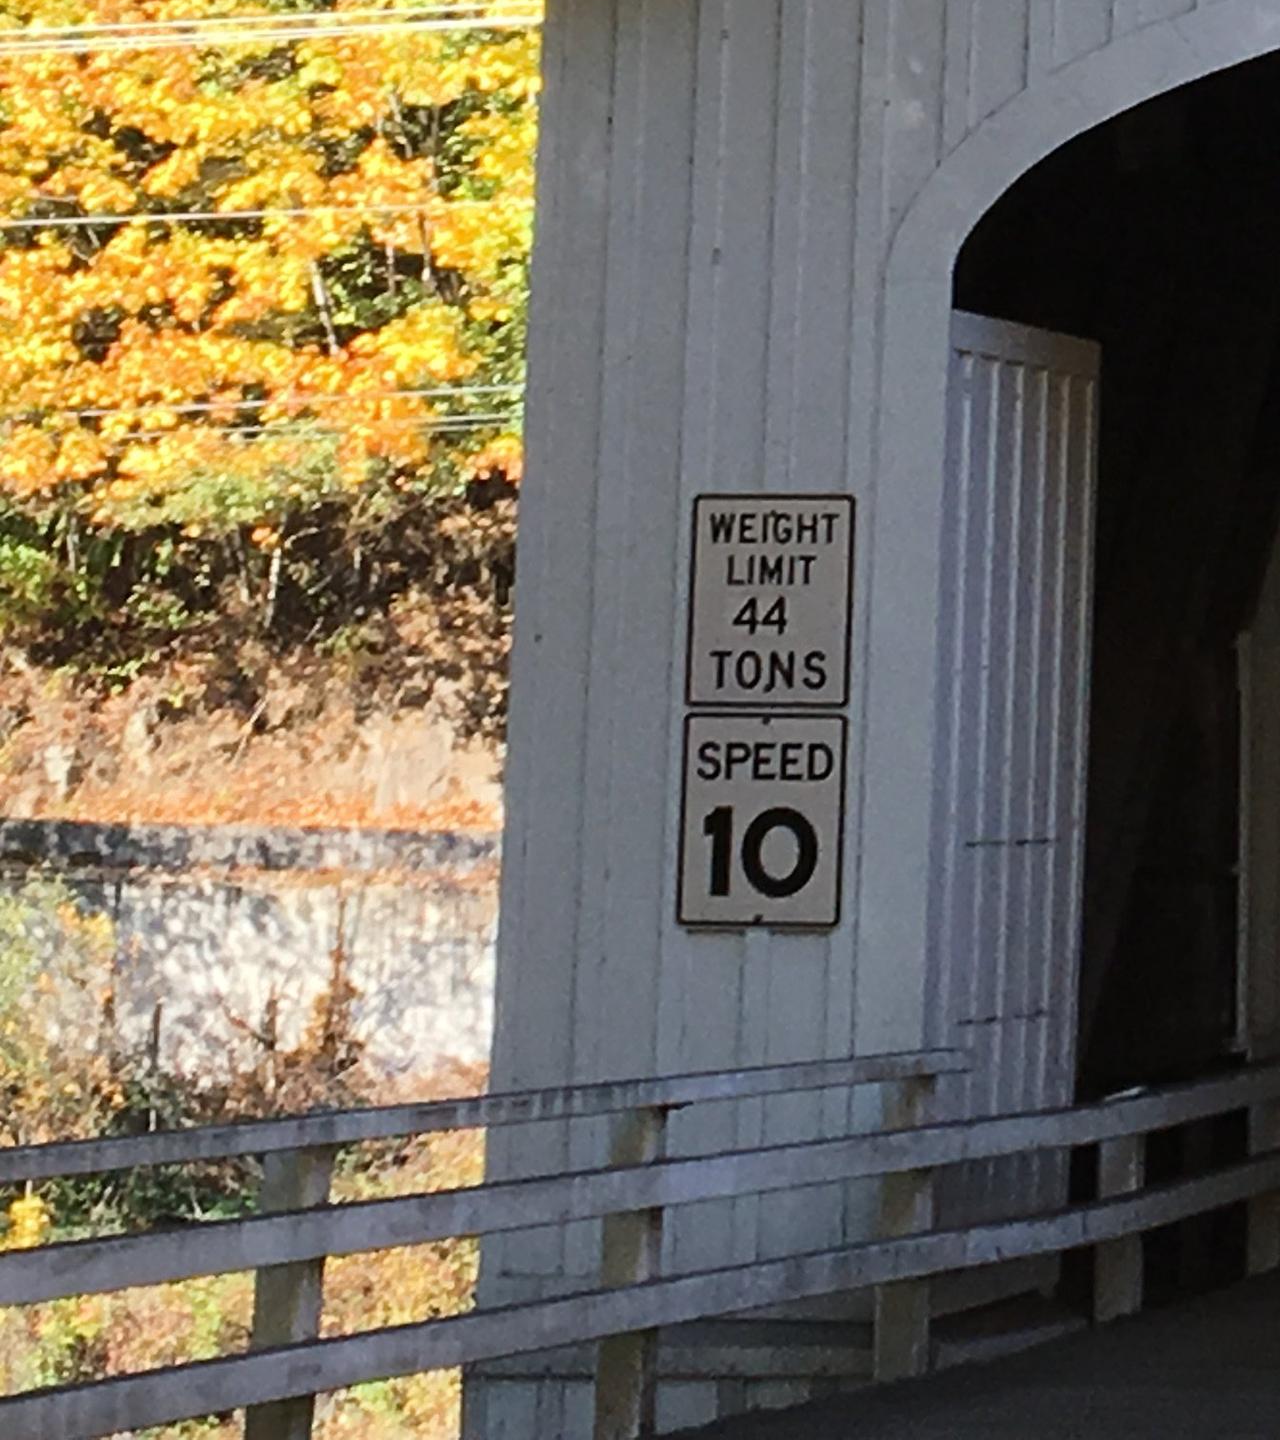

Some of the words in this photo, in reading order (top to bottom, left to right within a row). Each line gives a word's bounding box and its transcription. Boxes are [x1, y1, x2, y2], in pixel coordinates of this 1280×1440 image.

[710, 512, 840, 545] WEIGHT
[727, 554, 818, 586] LIMIT
[732, 596, 788, 636] 44
[709, 649, 827, 692] TONS
[697, 741, 834, 782] SPEED
[703, 805, 819, 899] 10
